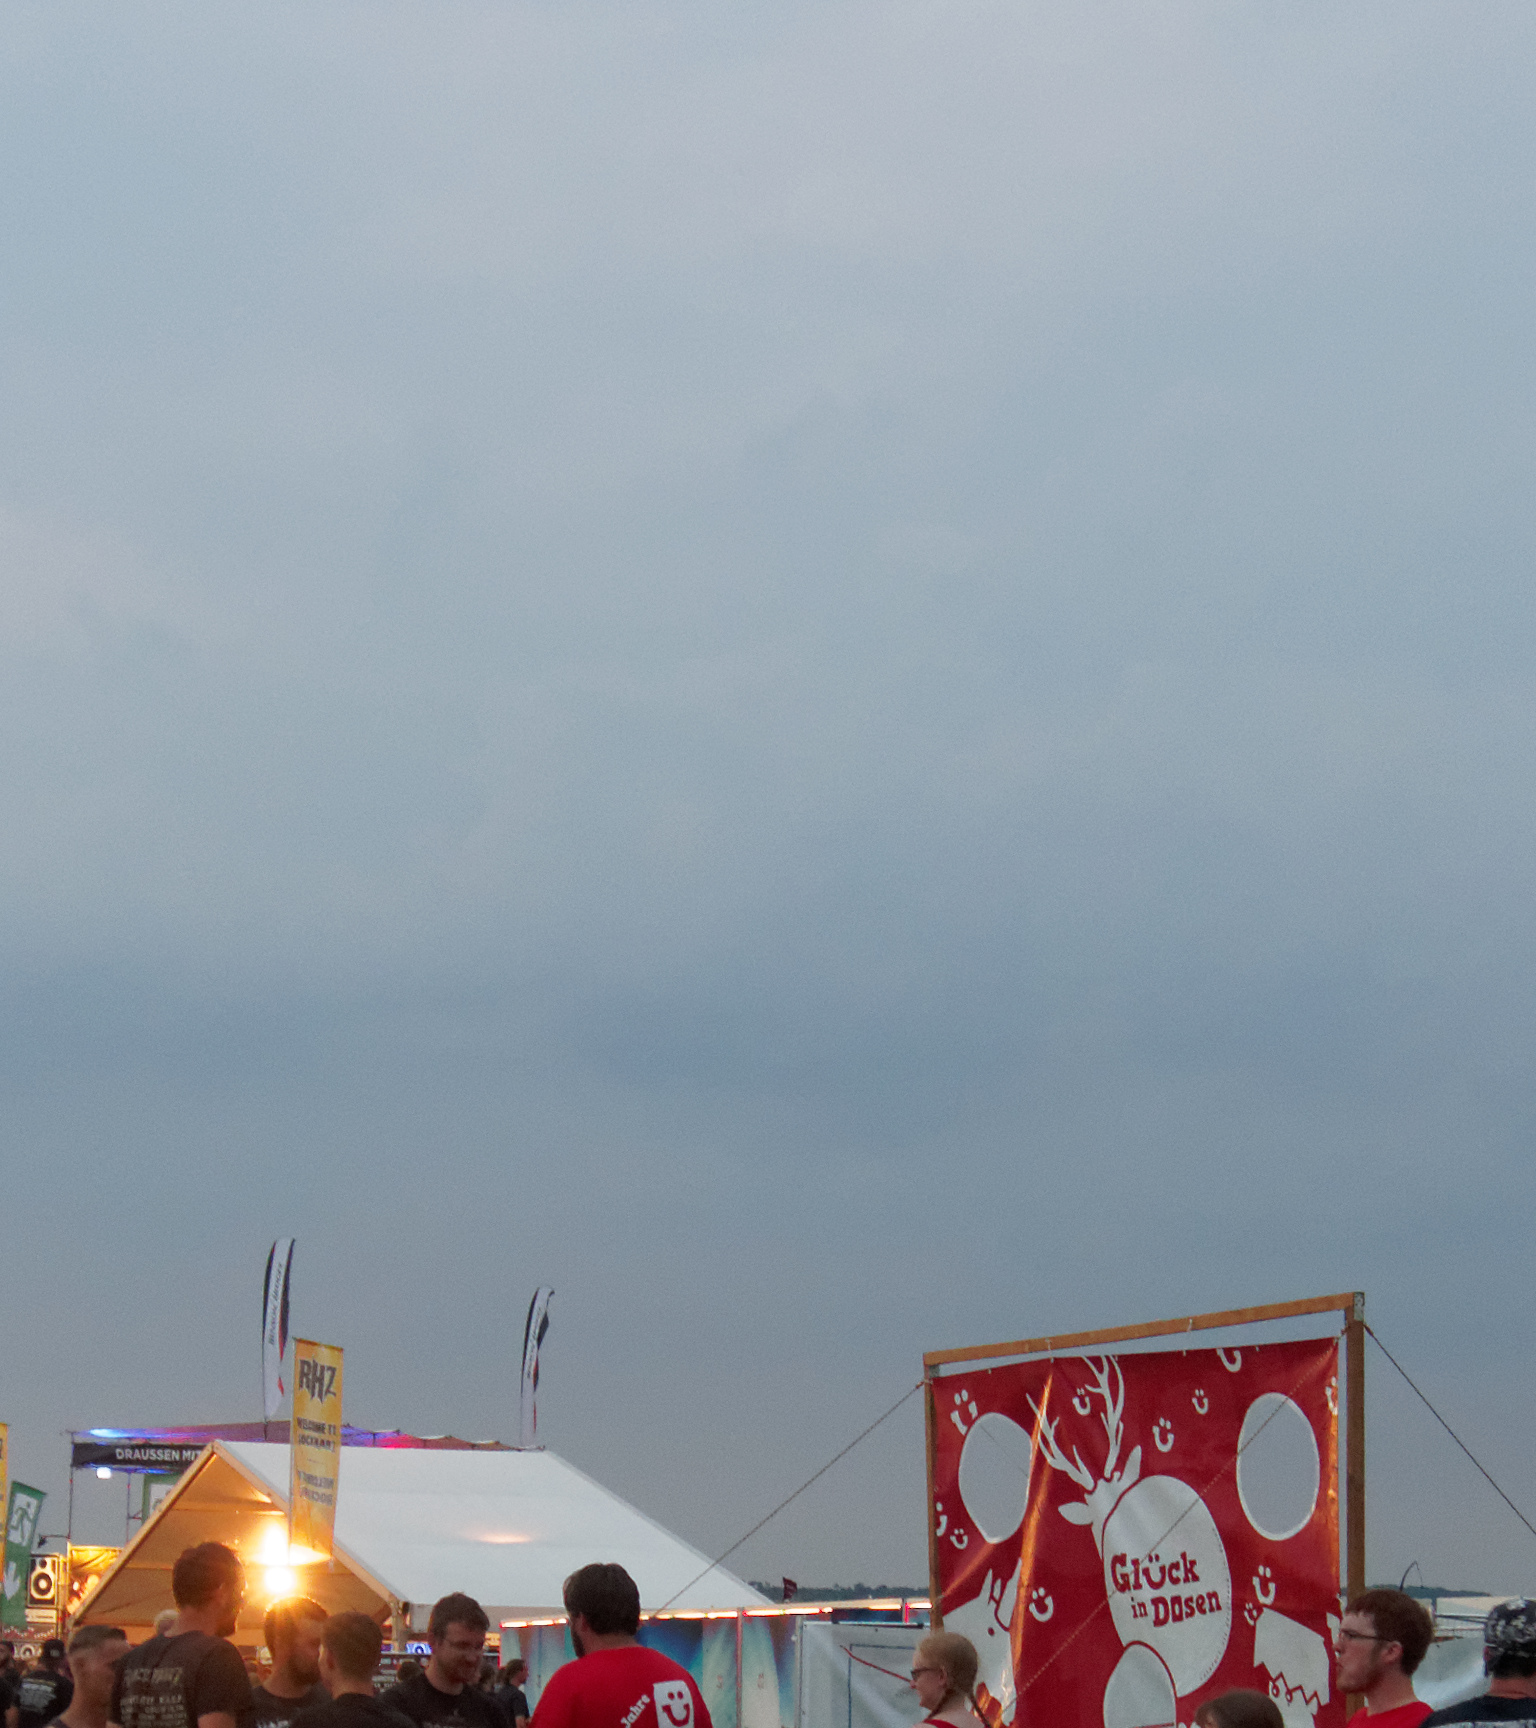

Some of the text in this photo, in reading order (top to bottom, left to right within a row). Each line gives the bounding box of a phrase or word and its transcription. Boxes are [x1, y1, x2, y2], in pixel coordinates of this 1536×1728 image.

[299, 1358, 337, 1404] RHZ
[115, 1448, 181, 1462] DRAUSSEN
[1110, 1551, 1200, 1593] Glück
[1131, 1590, 1222, 1627] in Dosen
